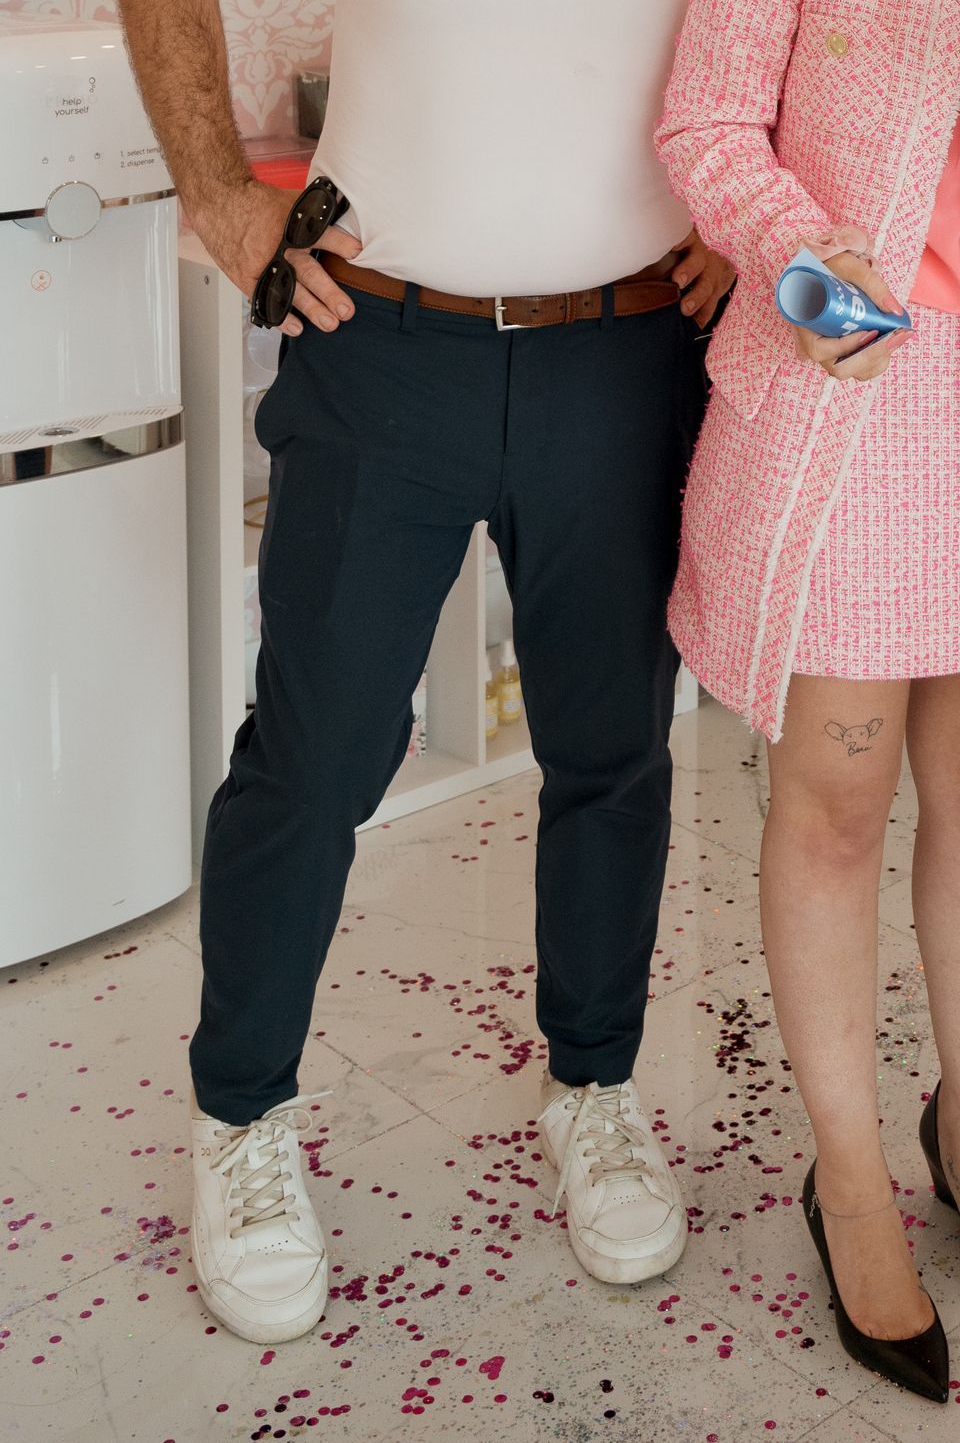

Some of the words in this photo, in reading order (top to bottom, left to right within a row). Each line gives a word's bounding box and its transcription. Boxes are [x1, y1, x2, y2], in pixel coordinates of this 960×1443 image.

[62, 98, 82, 107] help
[55, 106, 89, 117] yourself
[127, 148, 145, 158] select
[127, 158, 155, 168] dispense
